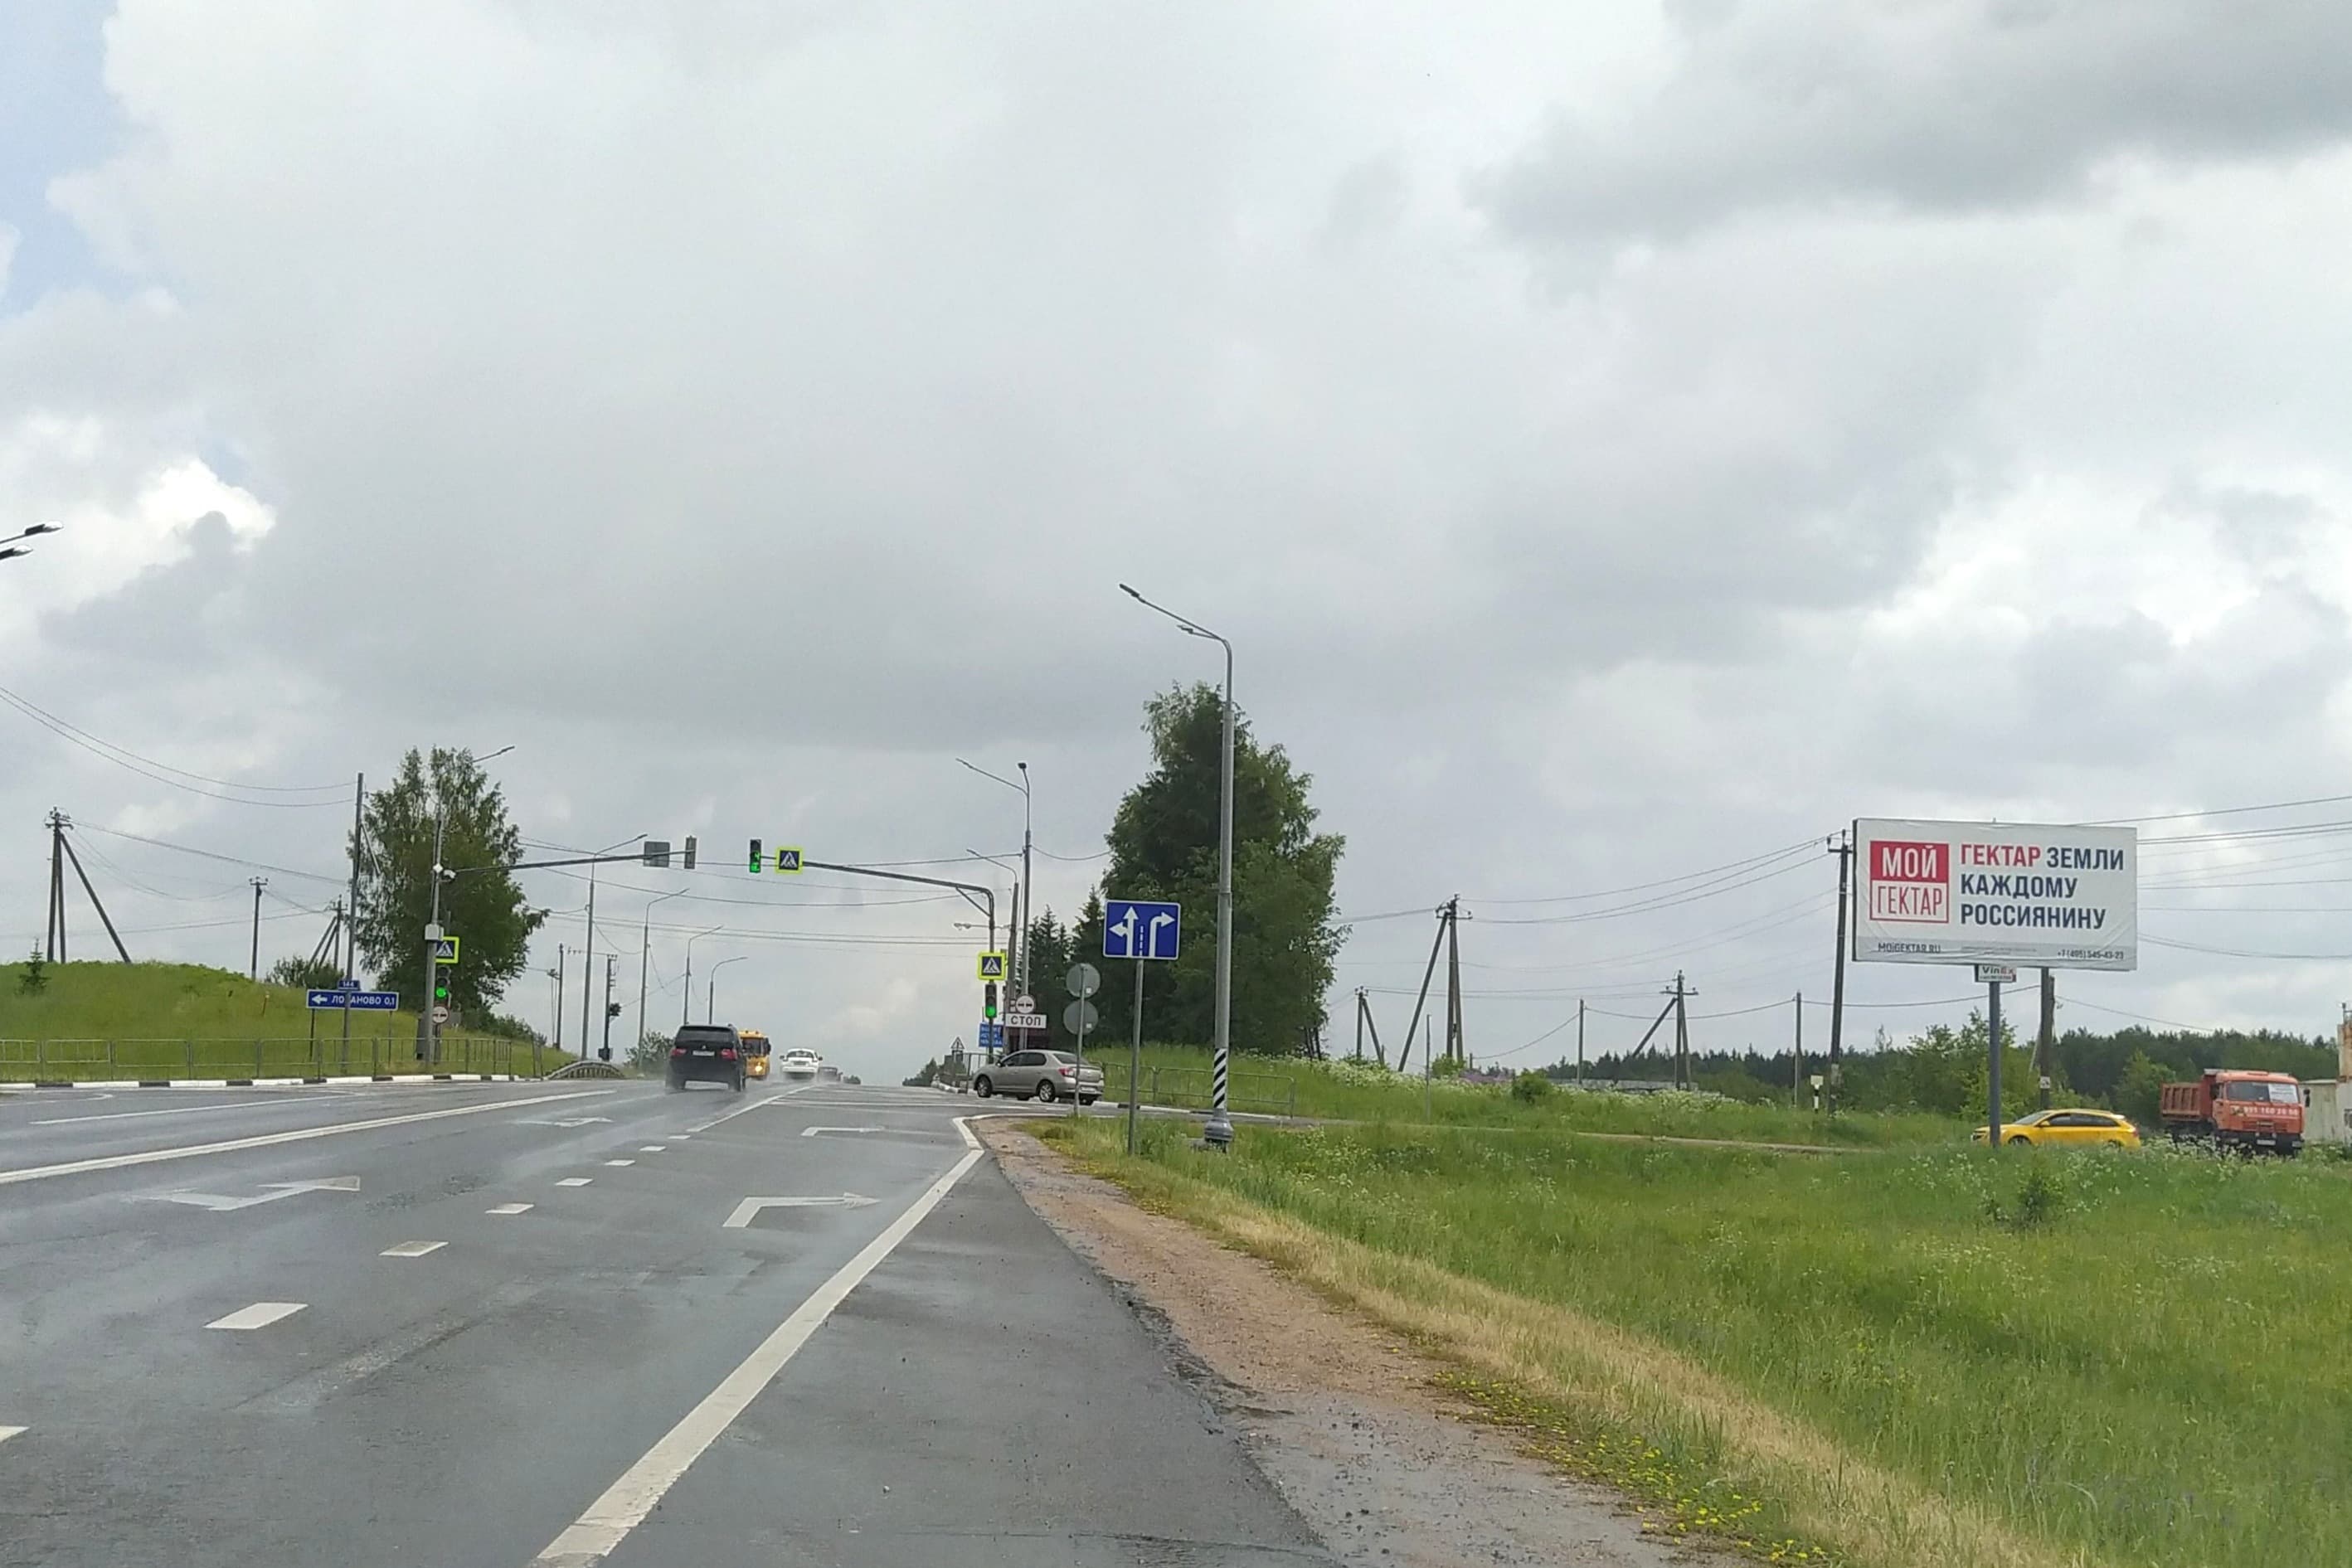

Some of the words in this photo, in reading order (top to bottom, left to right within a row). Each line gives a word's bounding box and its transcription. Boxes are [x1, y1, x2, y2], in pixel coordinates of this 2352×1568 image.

[1882, 845, 1937, 878] МОЙ
[1961, 843, 2041, 867] ГЕКТАР
[2046, 847, 2125, 871] ЗЕМЛИ
[1961, 873, 2078, 900] КАЖДОМУ
[1877, 886, 1943, 916] ГЕКТАР
[1961, 904, 2107, 930] РОССИЯНИНУ
[331, 995, 381, 1005] ЛОАНОВО
[1010, 1015, 1041, 1026] СТОП
